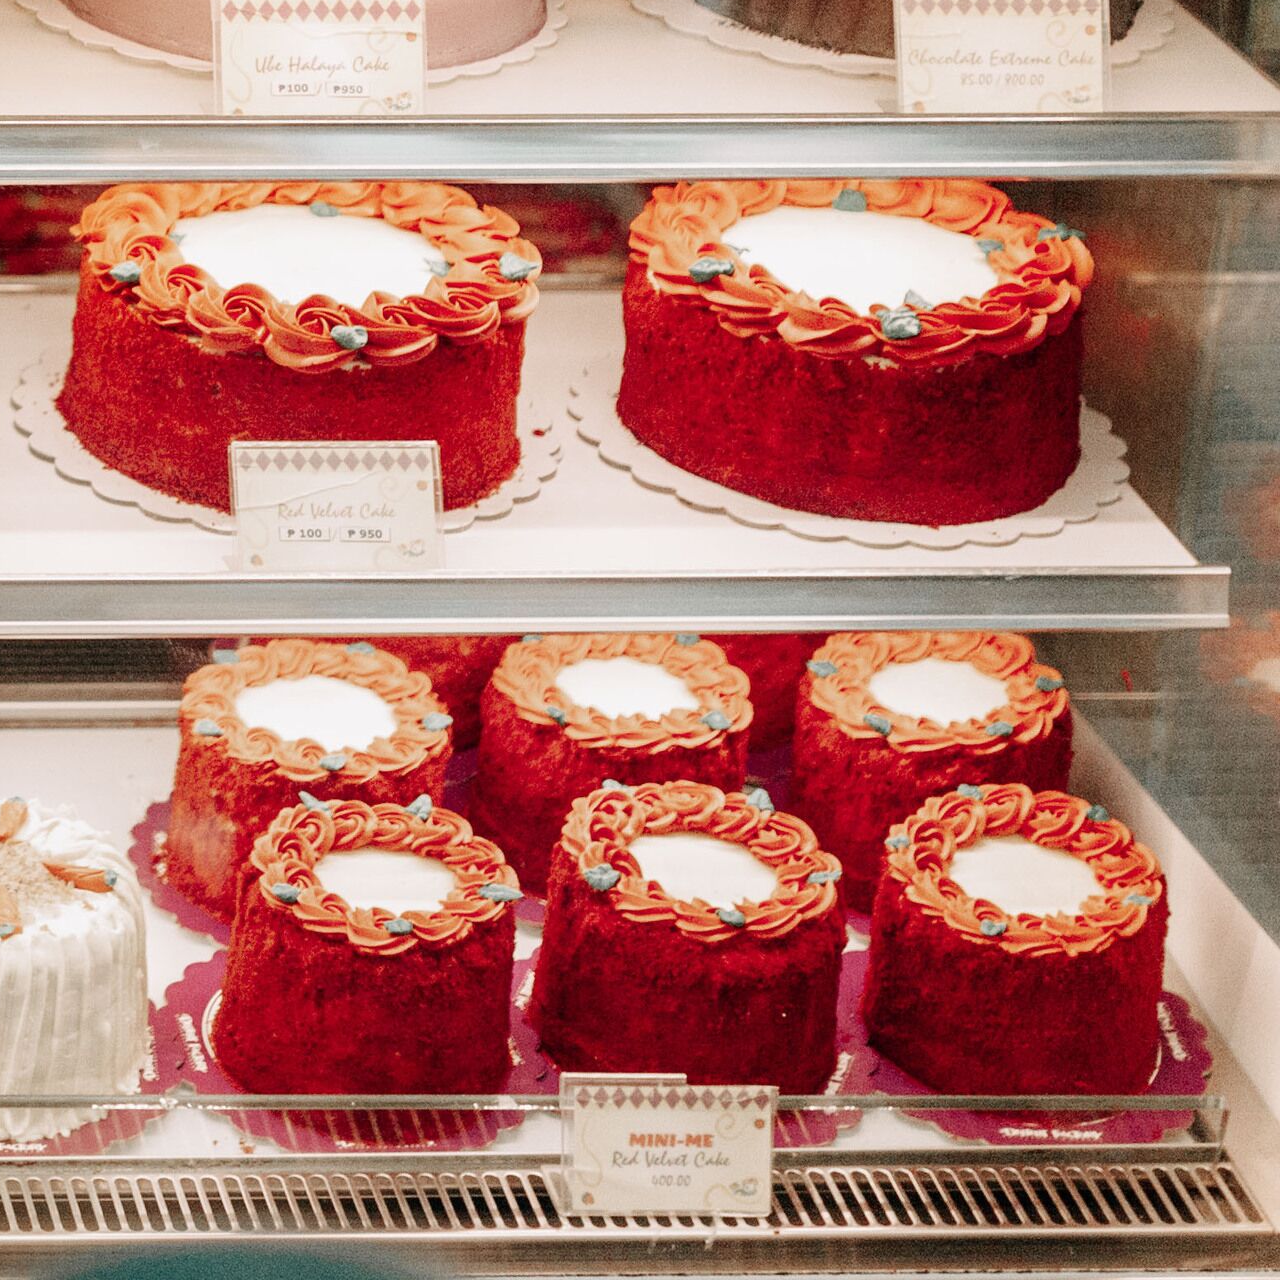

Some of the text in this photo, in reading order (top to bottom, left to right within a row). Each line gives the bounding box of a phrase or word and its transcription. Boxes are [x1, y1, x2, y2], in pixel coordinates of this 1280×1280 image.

[254, 55, 390, 78] Ube Halaya Cake
[907, 48, 1097, 67] Chocolate Extreme Cake
[278, 502, 396, 520] Red Velvet Cake
[629, 1133, 715, 1148] MINI-ME
[612, 1151, 731, 1168] Red Velvet Cake
